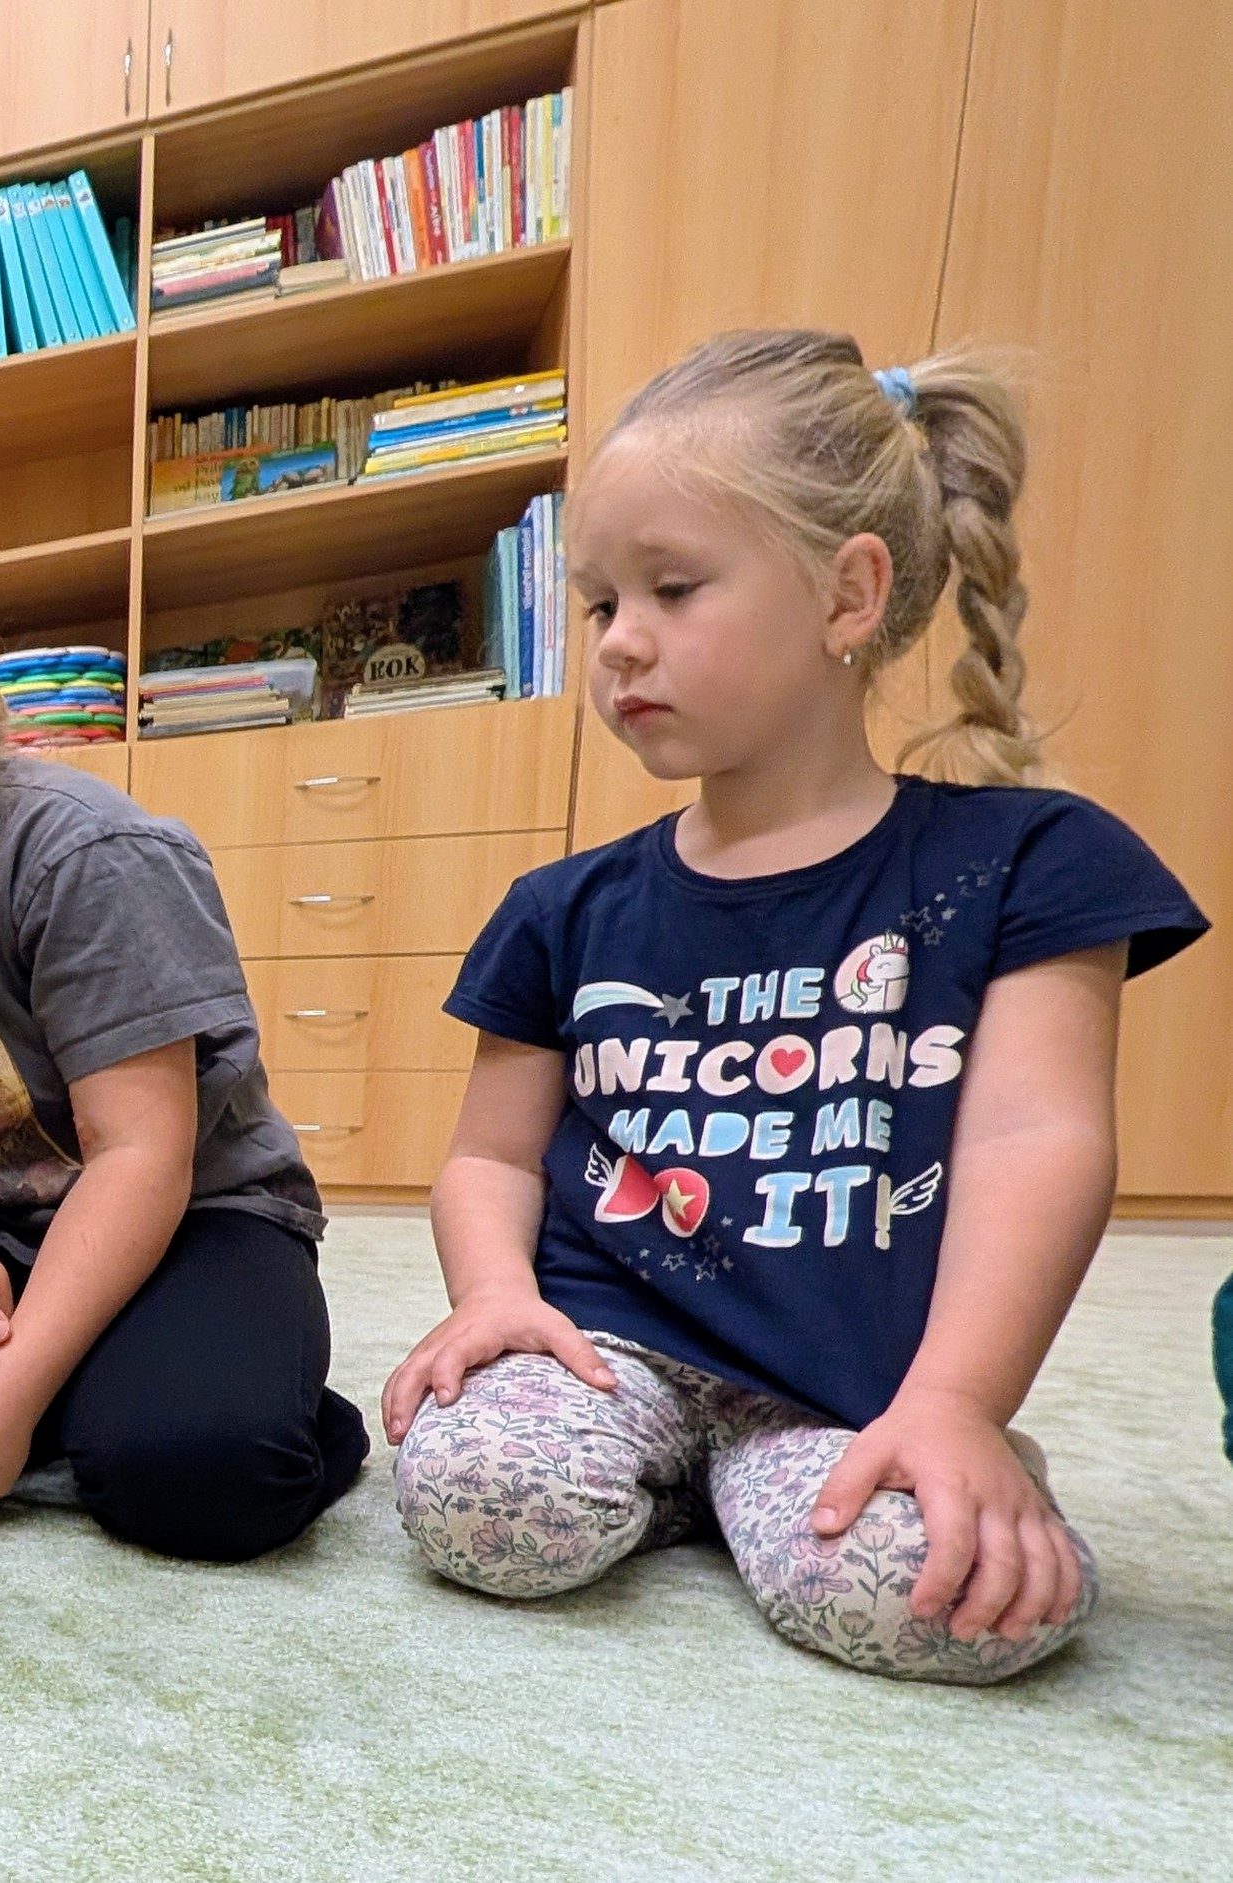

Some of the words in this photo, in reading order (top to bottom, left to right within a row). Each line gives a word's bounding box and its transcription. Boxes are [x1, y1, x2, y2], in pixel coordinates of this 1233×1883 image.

[369, 656, 420, 682] ROK
[698, 967, 826, 1027] THE
[572, 1022, 967, 1098] UNICORNS
[607, 1108, 795, 1160] MADE
[811, 1097, 895, 1155] ME
[742, 1165, 892, 1251] IT!
